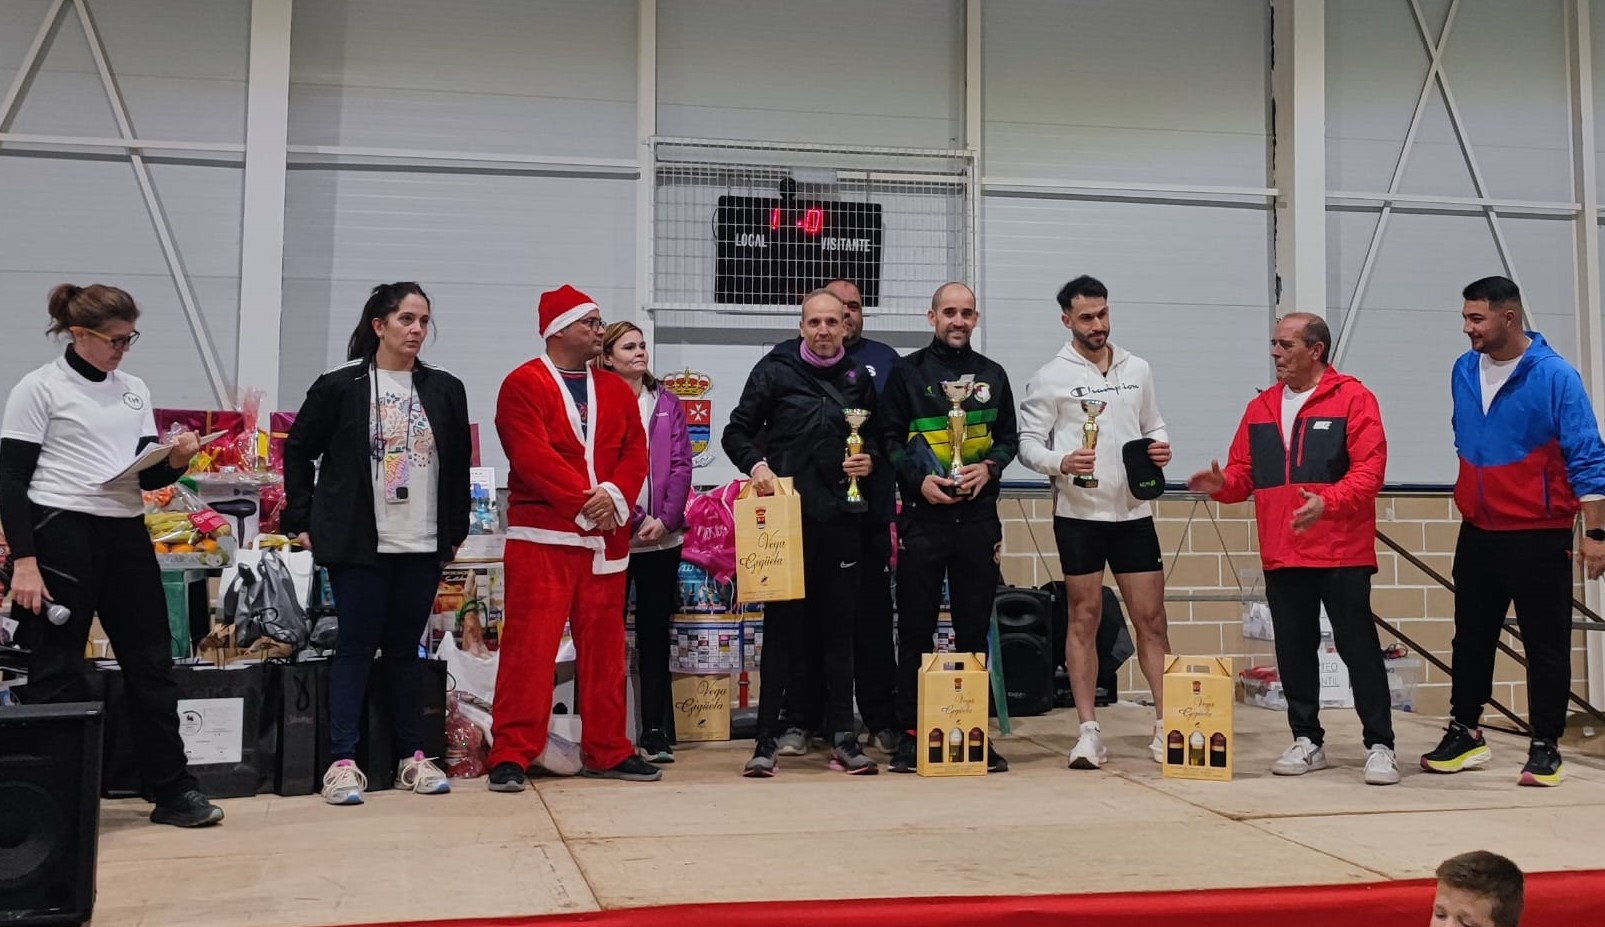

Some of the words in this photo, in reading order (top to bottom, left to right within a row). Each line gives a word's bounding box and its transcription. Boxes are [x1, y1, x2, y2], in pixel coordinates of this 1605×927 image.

[735, 232, 768, 248] LOCAL
[821, 237, 871, 252] VISITANTE
[1070, 383, 1140, 397] Champion
[758, 530, 786, 554] Vega
[697, 681, 727, 700] Vega
